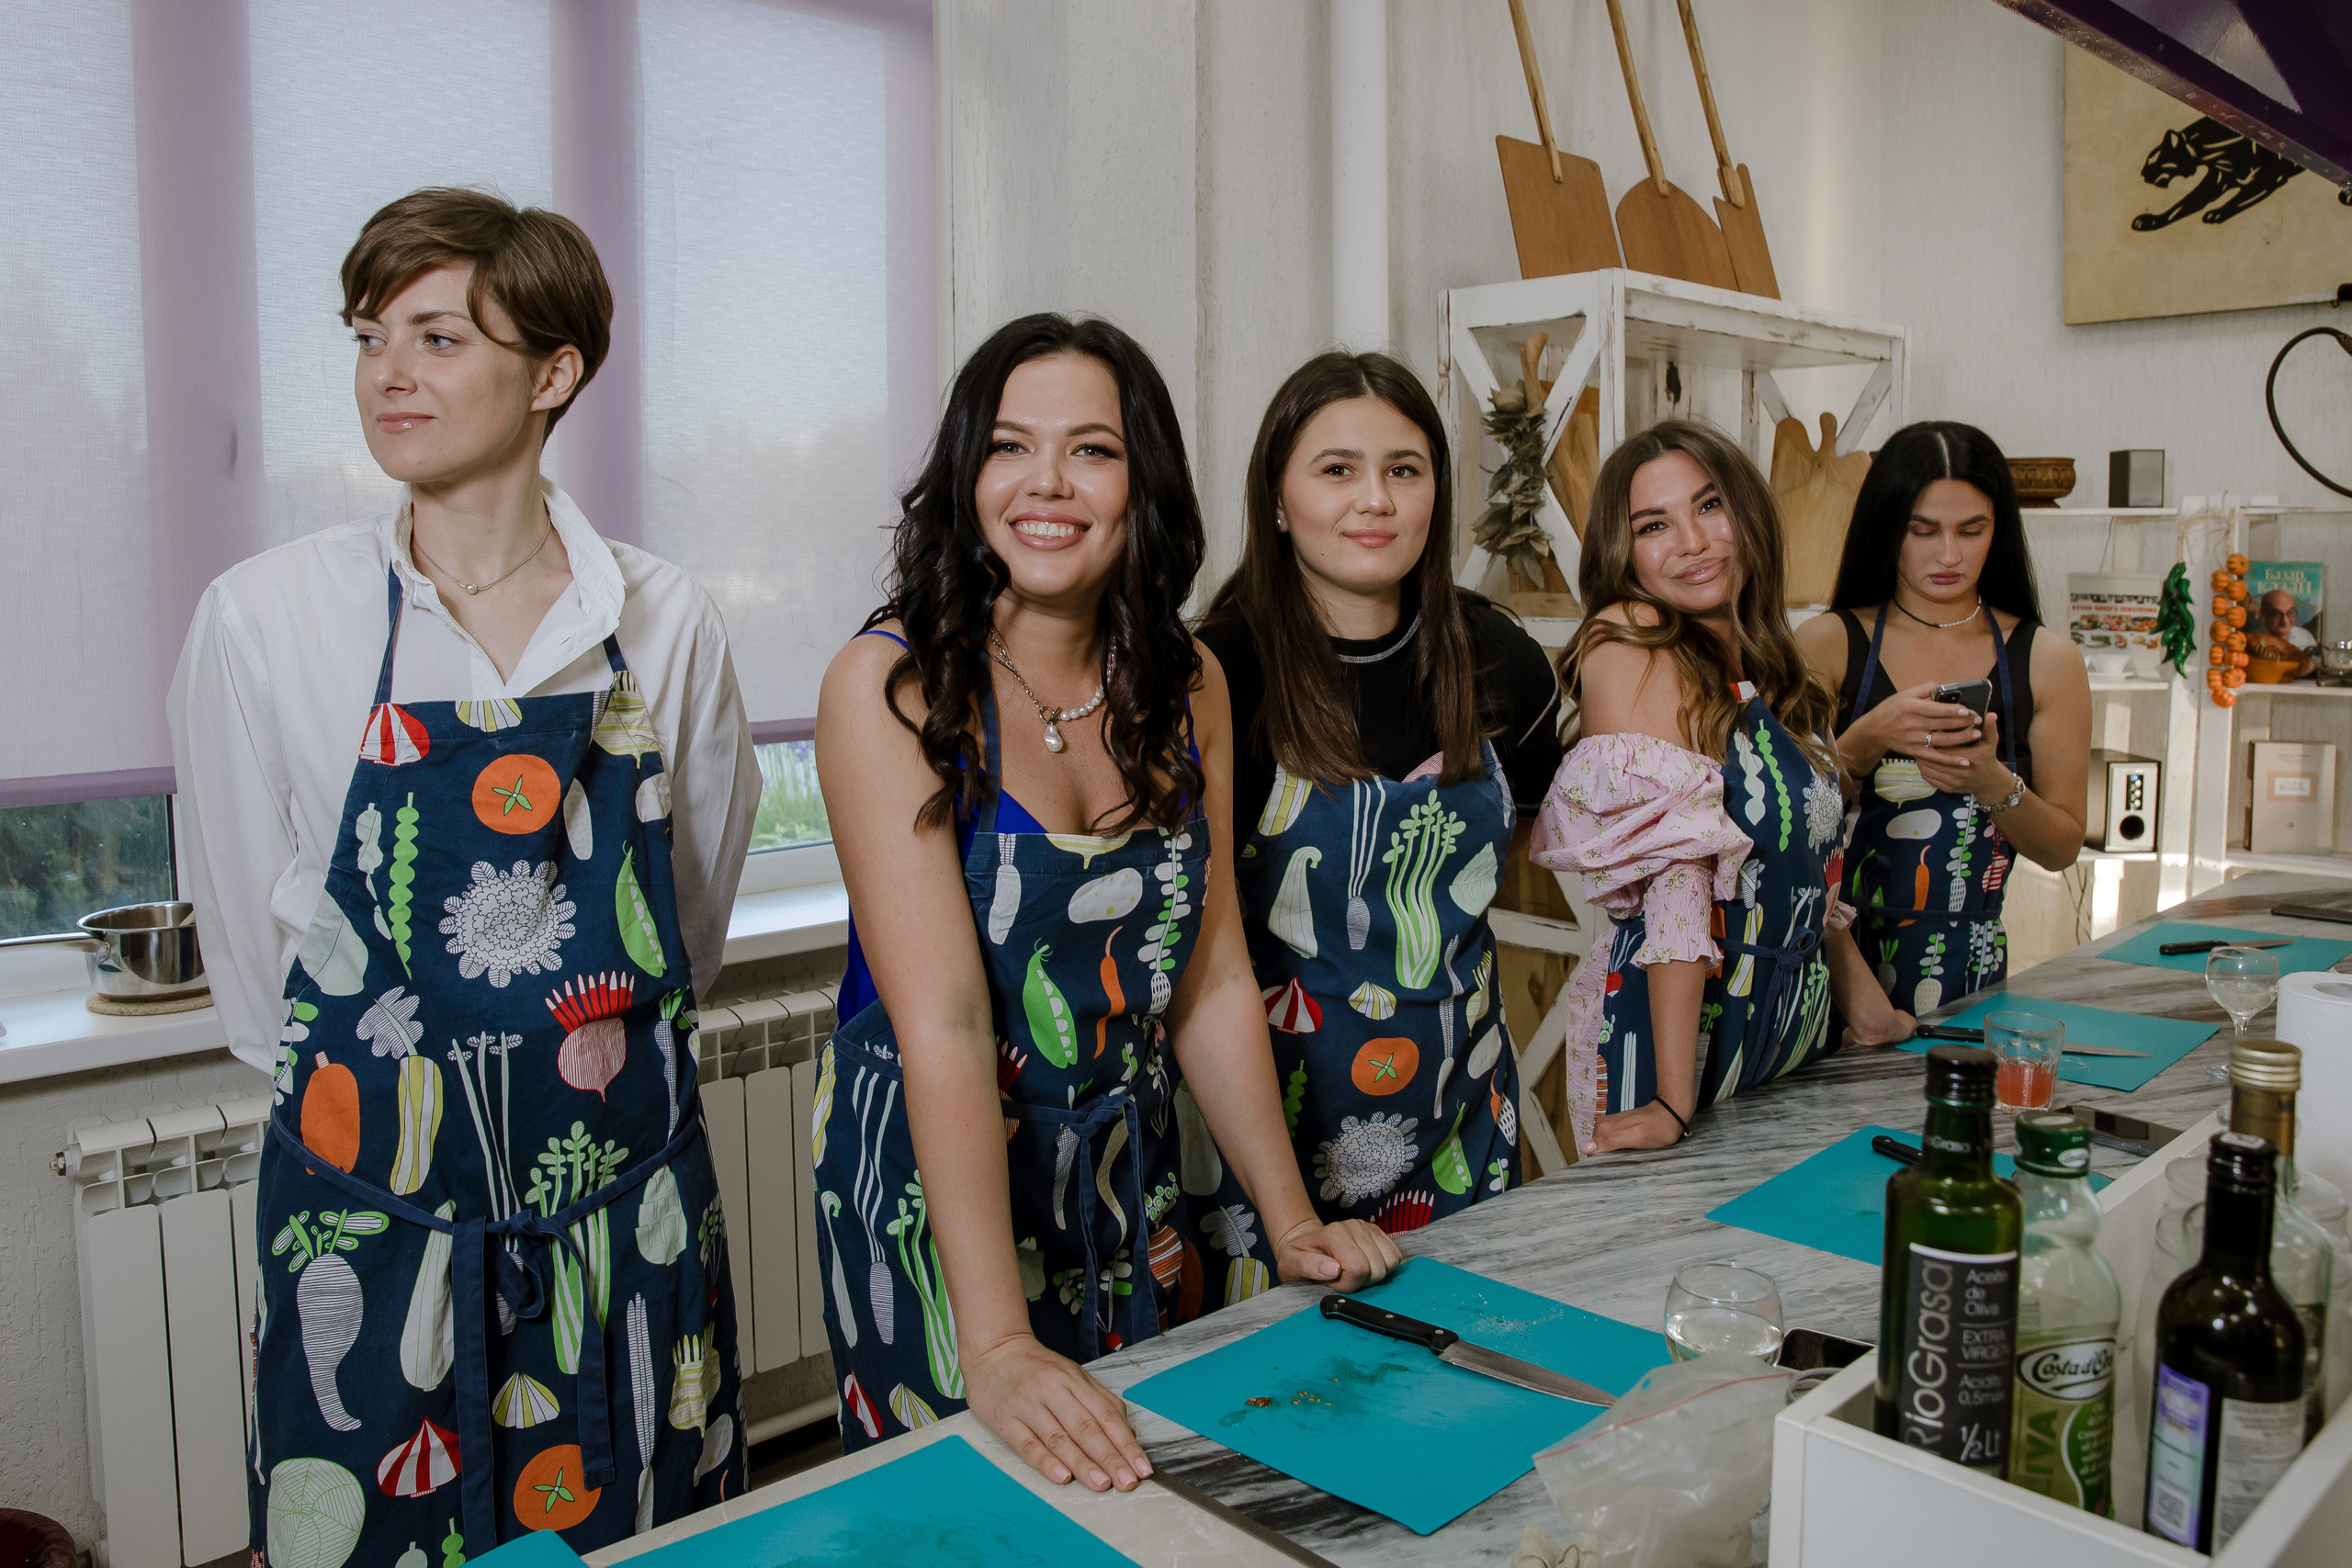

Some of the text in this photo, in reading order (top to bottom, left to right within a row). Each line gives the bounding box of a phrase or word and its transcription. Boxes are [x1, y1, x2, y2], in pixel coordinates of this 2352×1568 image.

[1964, 1285, 1986, 1301] de
[1962, 1328, 2006, 1345] EXTRA
[1905, 1259, 1953, 1456] RioGrasa
[2031, 1352, 2079, 1383] Costa
